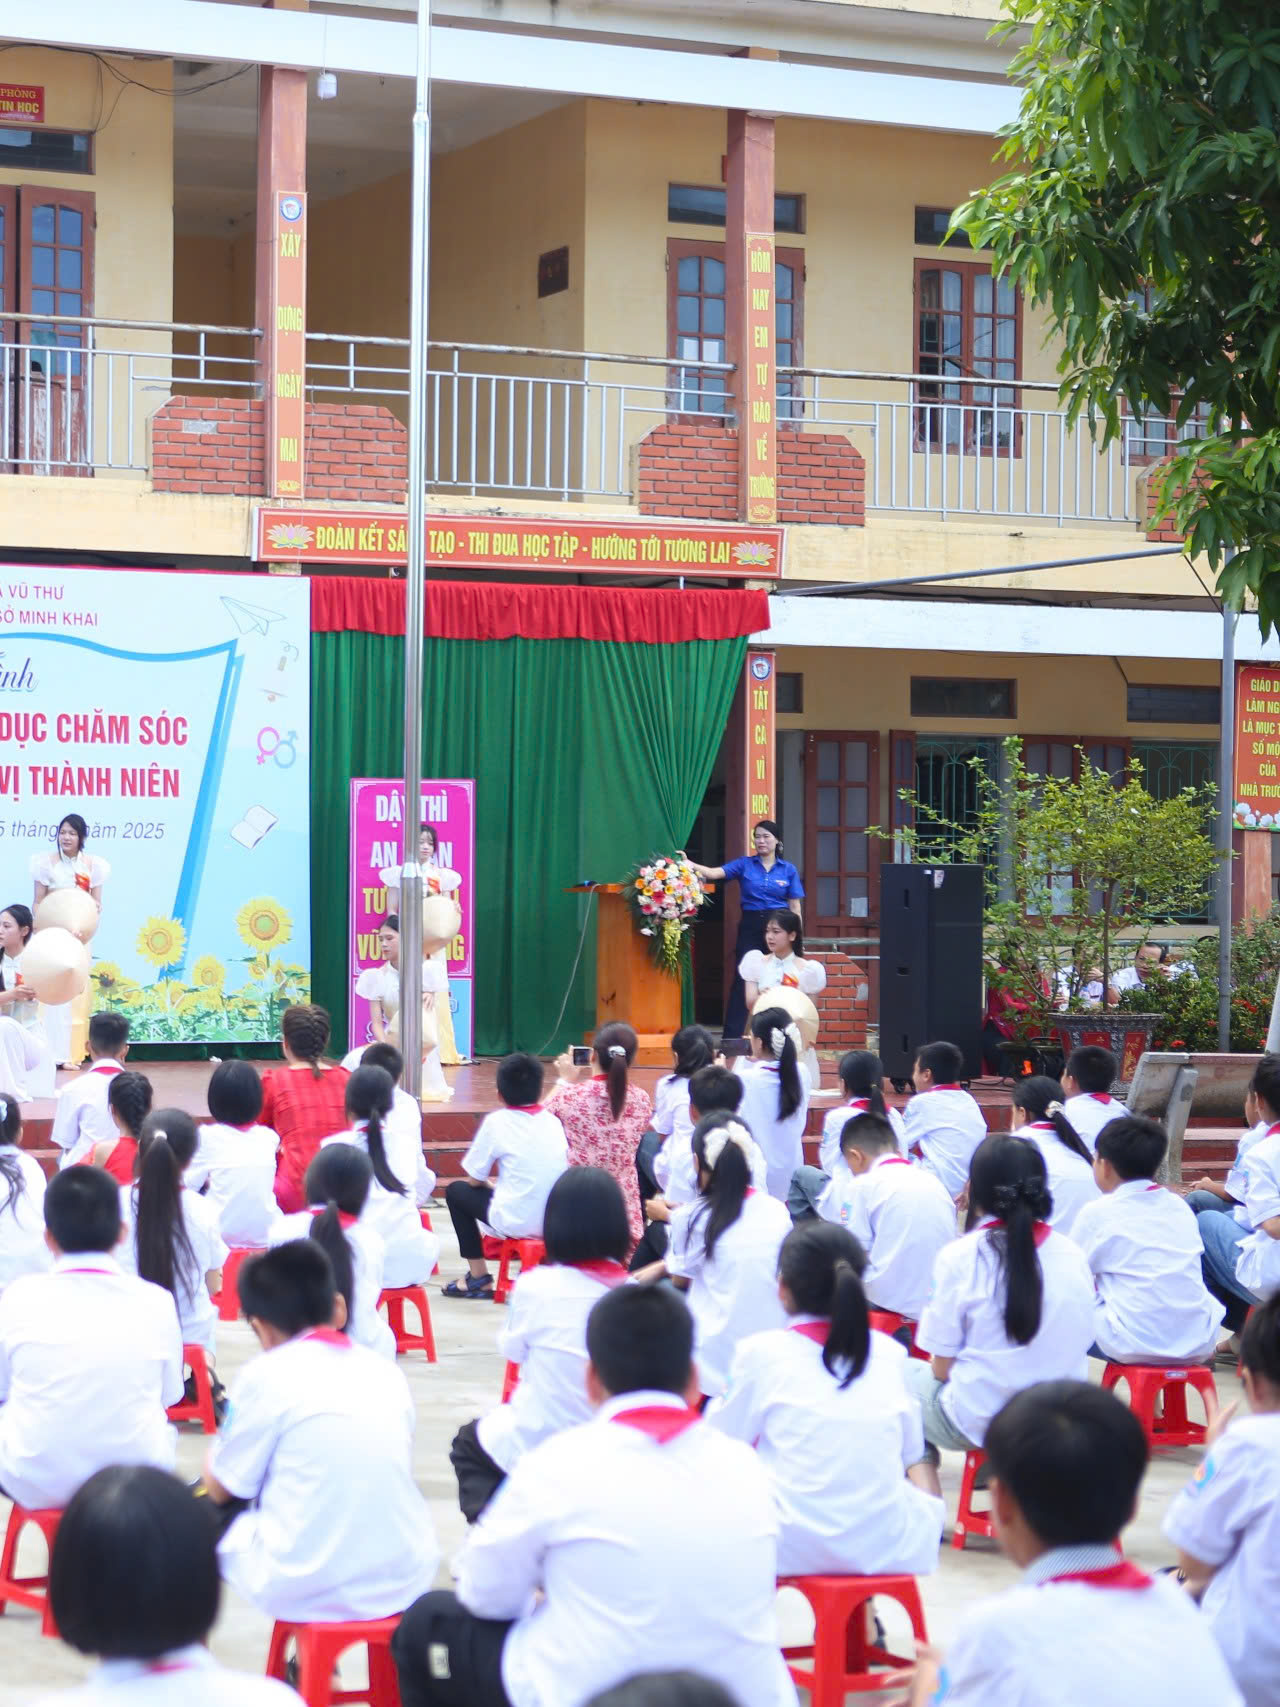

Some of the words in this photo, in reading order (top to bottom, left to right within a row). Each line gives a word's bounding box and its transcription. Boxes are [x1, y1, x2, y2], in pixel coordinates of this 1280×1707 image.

[280, 228, 301, 258] XÂY
[751, 246, 771, 273] HÔM
[752, 288, 770, 311] NAY
[754, 325, 768, 348] EM
[277, 369, 302, 399] NGÀY
[755, 362, 769, 391] TỰ
[752, 396, 771, 424] HÀO
[279, 436, 298, 463] MAI
[316, 522, 355, 551] ĐOÀN
[358, 521, 384, 552] KẾT
[387, 524, 411, 553] SÁ
[429, 530, 456, 559] TẠO
[468, 531, 489, 555] THI
[492, 533, 519, 556] ĐUA
[522, 534, 550, 562] HỌC
[553, 531, 579, 563] TẬP
[591, 532, 637, 561] HƯỚNG
[640, 534, 661, 561] TỚI
[664, 538, 707, 563] TƯƠNG
[710, 541, 730, 564] LAI
[8, 581, 29, 599] VŨ
[33, 585, 64, 600] THƯ
[19, 610, 57, 625] MINH
[62, 611, 98, 627] KHAI
[1251, 677, 1271, 693] GIÁO
[1246, 697, 1265, 713] LÀM
[56, 708, 130, 745] CHĂM
[139, 710, 188, 746] SÓC
[1242, 718, 1254, 733] LÀ
[1255, 721, 1275, 737] MỤC
[1266, 741, 1280, 759] MỘ
[28, 760, 112, 797] THÀNH
[120, 762, 180, 798] NIÊN
[756, 755, 766, 780] VÌ
[1240, 781, 1259, 797] NHÀ
[375, 789, 406, 828] DẬ
[752, 794, 770, 819] HỌC
[11, 820, 59, 842] tháng
[122, 822, 166, 840] 2025
[370, 841, 398, 868] AN
